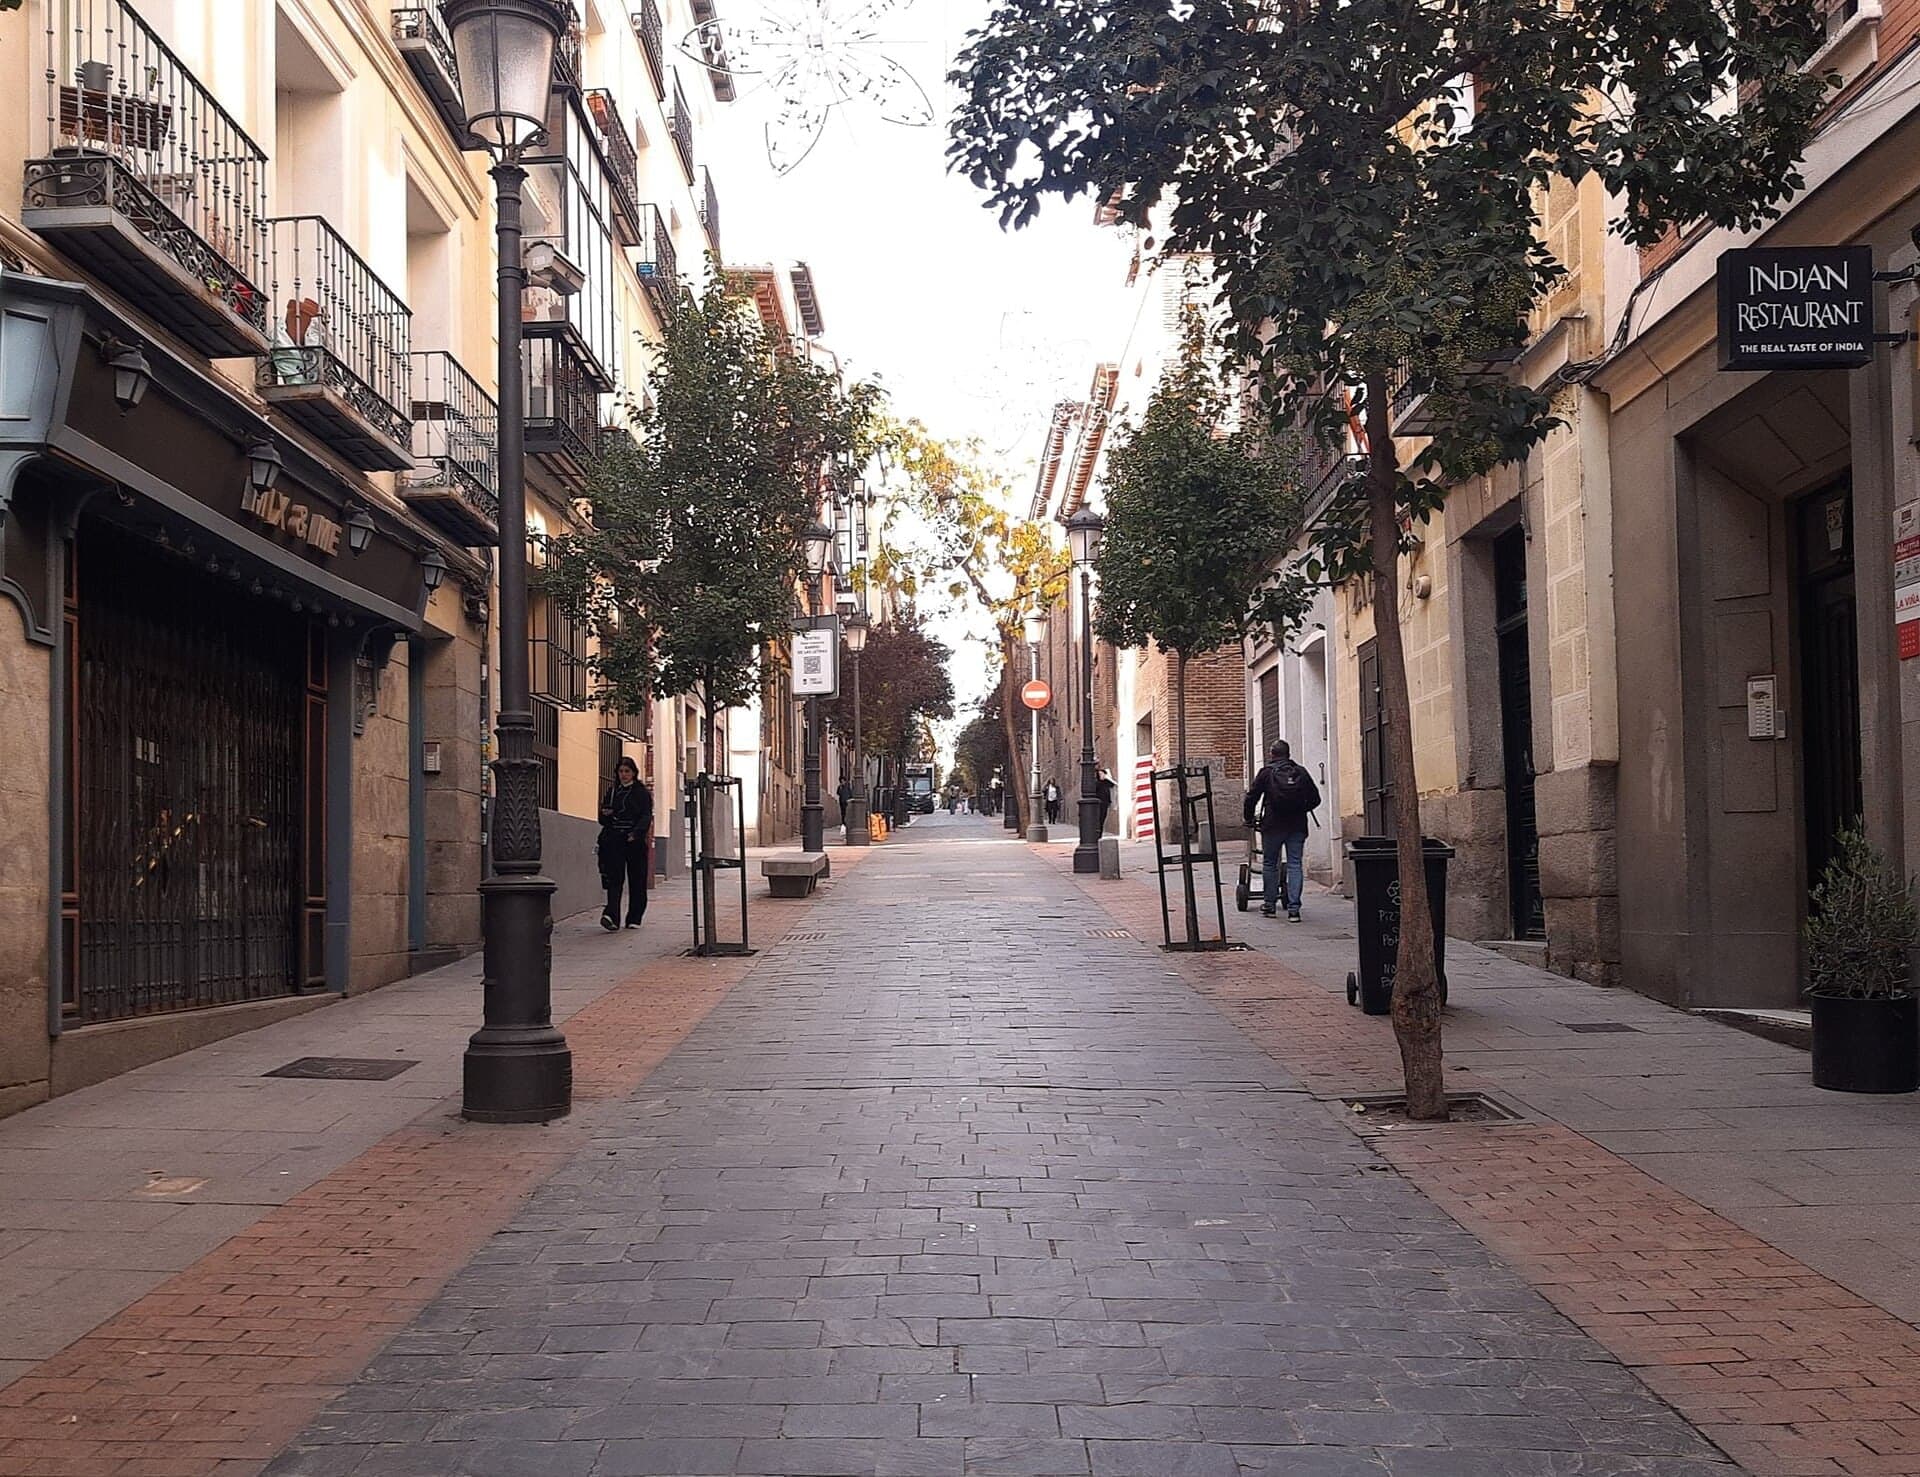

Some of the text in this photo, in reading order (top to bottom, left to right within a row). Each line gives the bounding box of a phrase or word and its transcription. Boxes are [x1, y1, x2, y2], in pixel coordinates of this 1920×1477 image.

[1749, 260, 1848, 296] INDIAN
[1738, 301, 1864, 332] RESTAURANT
[1740, 342, 1864, 353] THE REAL TASTE OF INDIA
